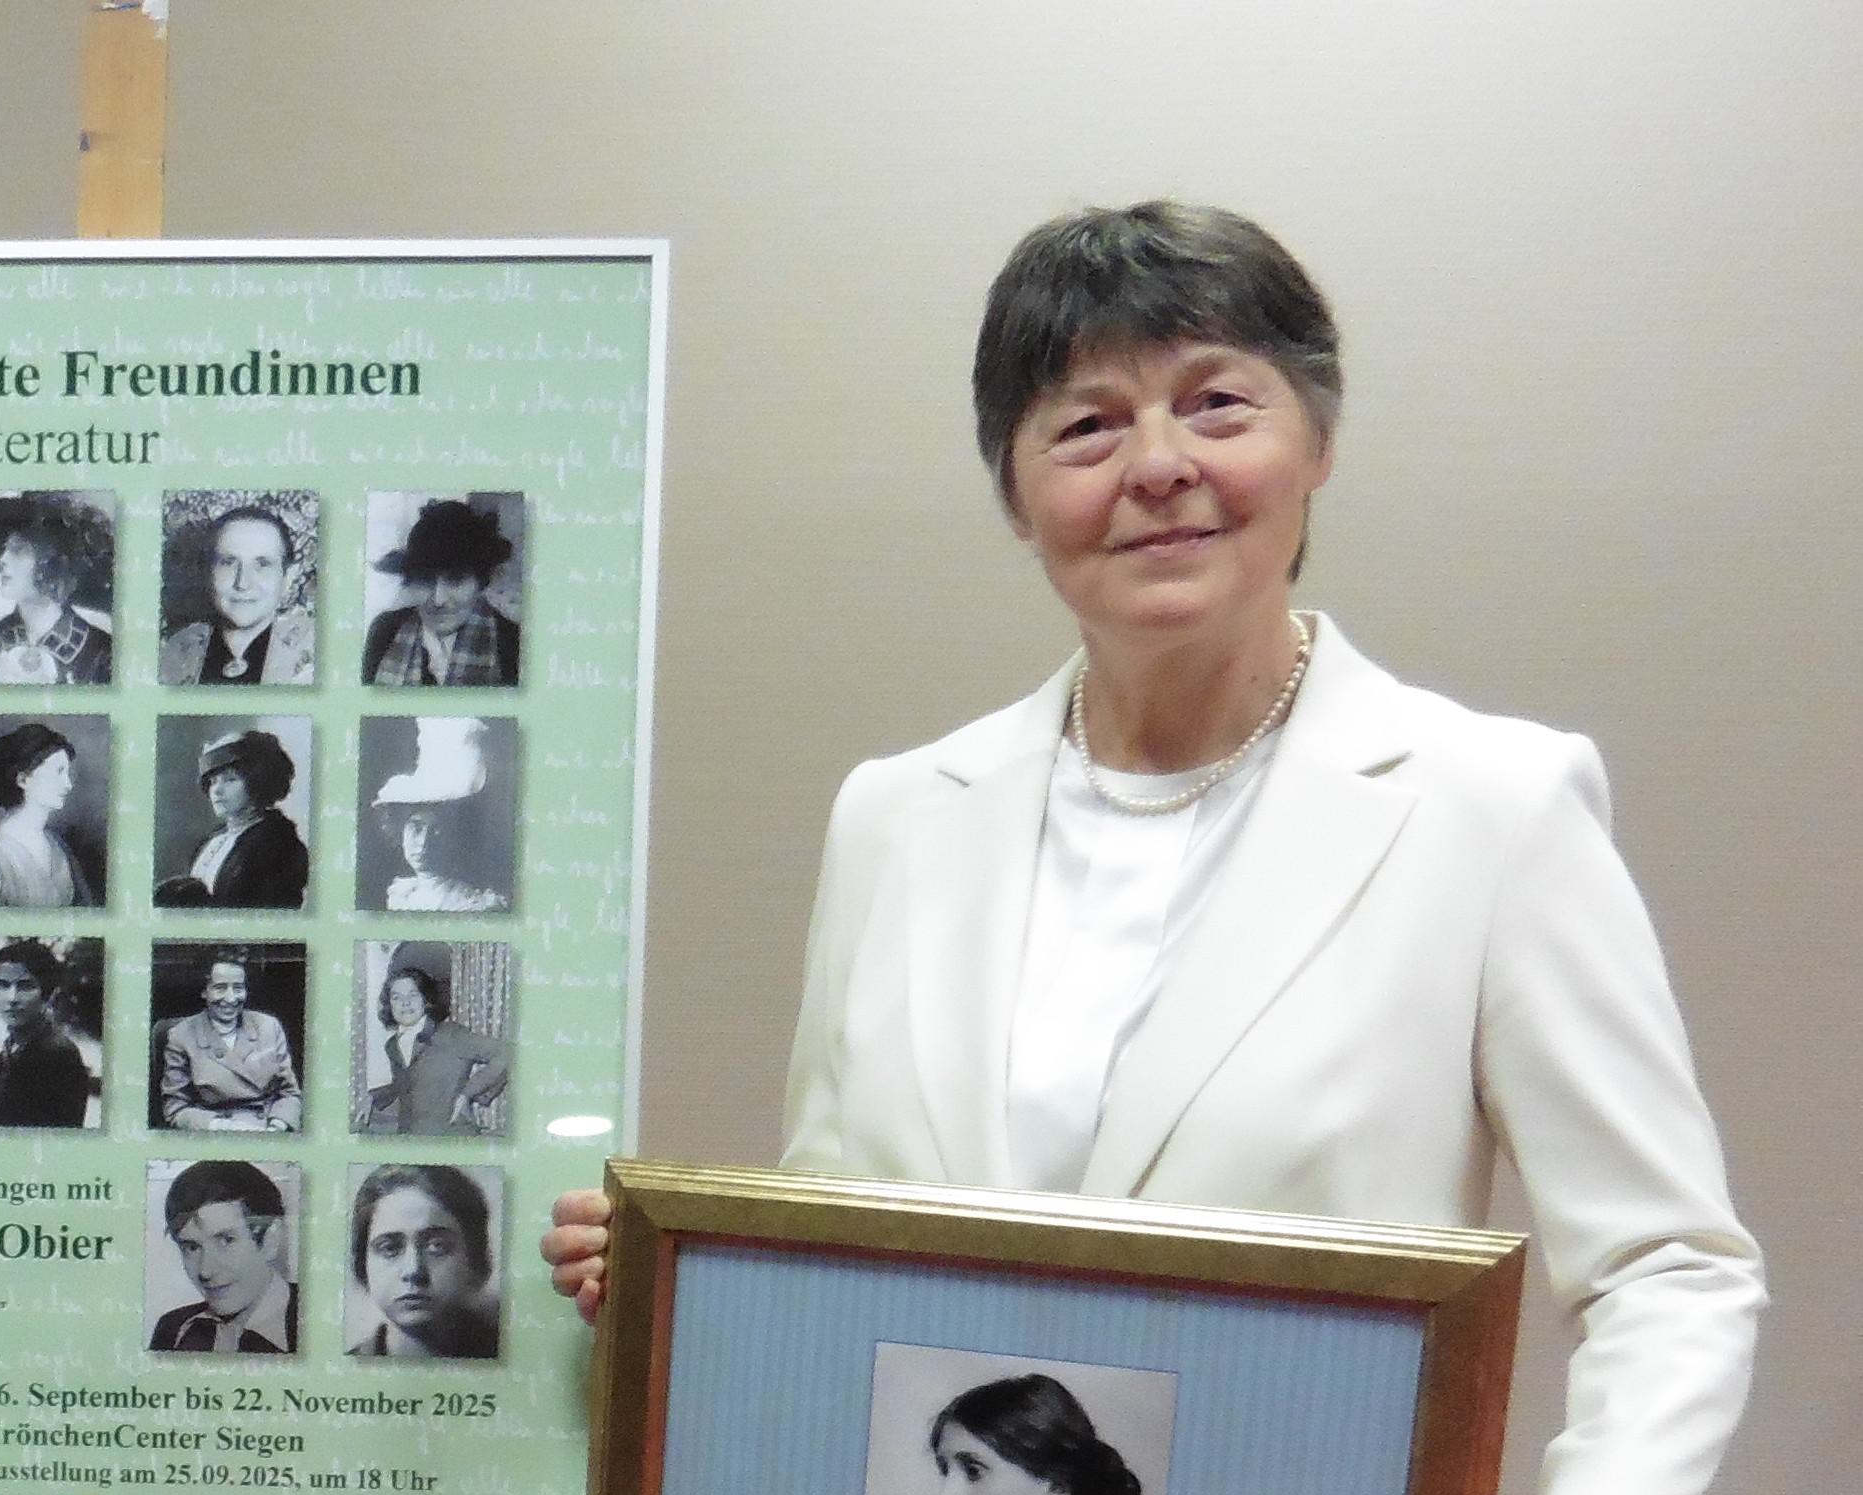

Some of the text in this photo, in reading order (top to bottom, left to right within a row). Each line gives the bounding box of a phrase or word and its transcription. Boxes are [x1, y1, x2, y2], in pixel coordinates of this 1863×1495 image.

[61, 349, 420, 397] Freundinnen
[67, 1176, 113, 1200] mit
[27, 1383, 176, 1413] September
[185, 1387, 223, 1410] bis
[233, 1388, 272, 1412] 22.
[282, 1389, 423, 1415] November
[432, 1393, 496, 1417] 2025
[216, 1427, 304, 1458] Siegen
[120, 1469, 156, 1484] am
[310, 1474, 346, 1488] um
[358, 1469, 381, 1489] 18
[391, 1470, 438, 1491] Uhr
